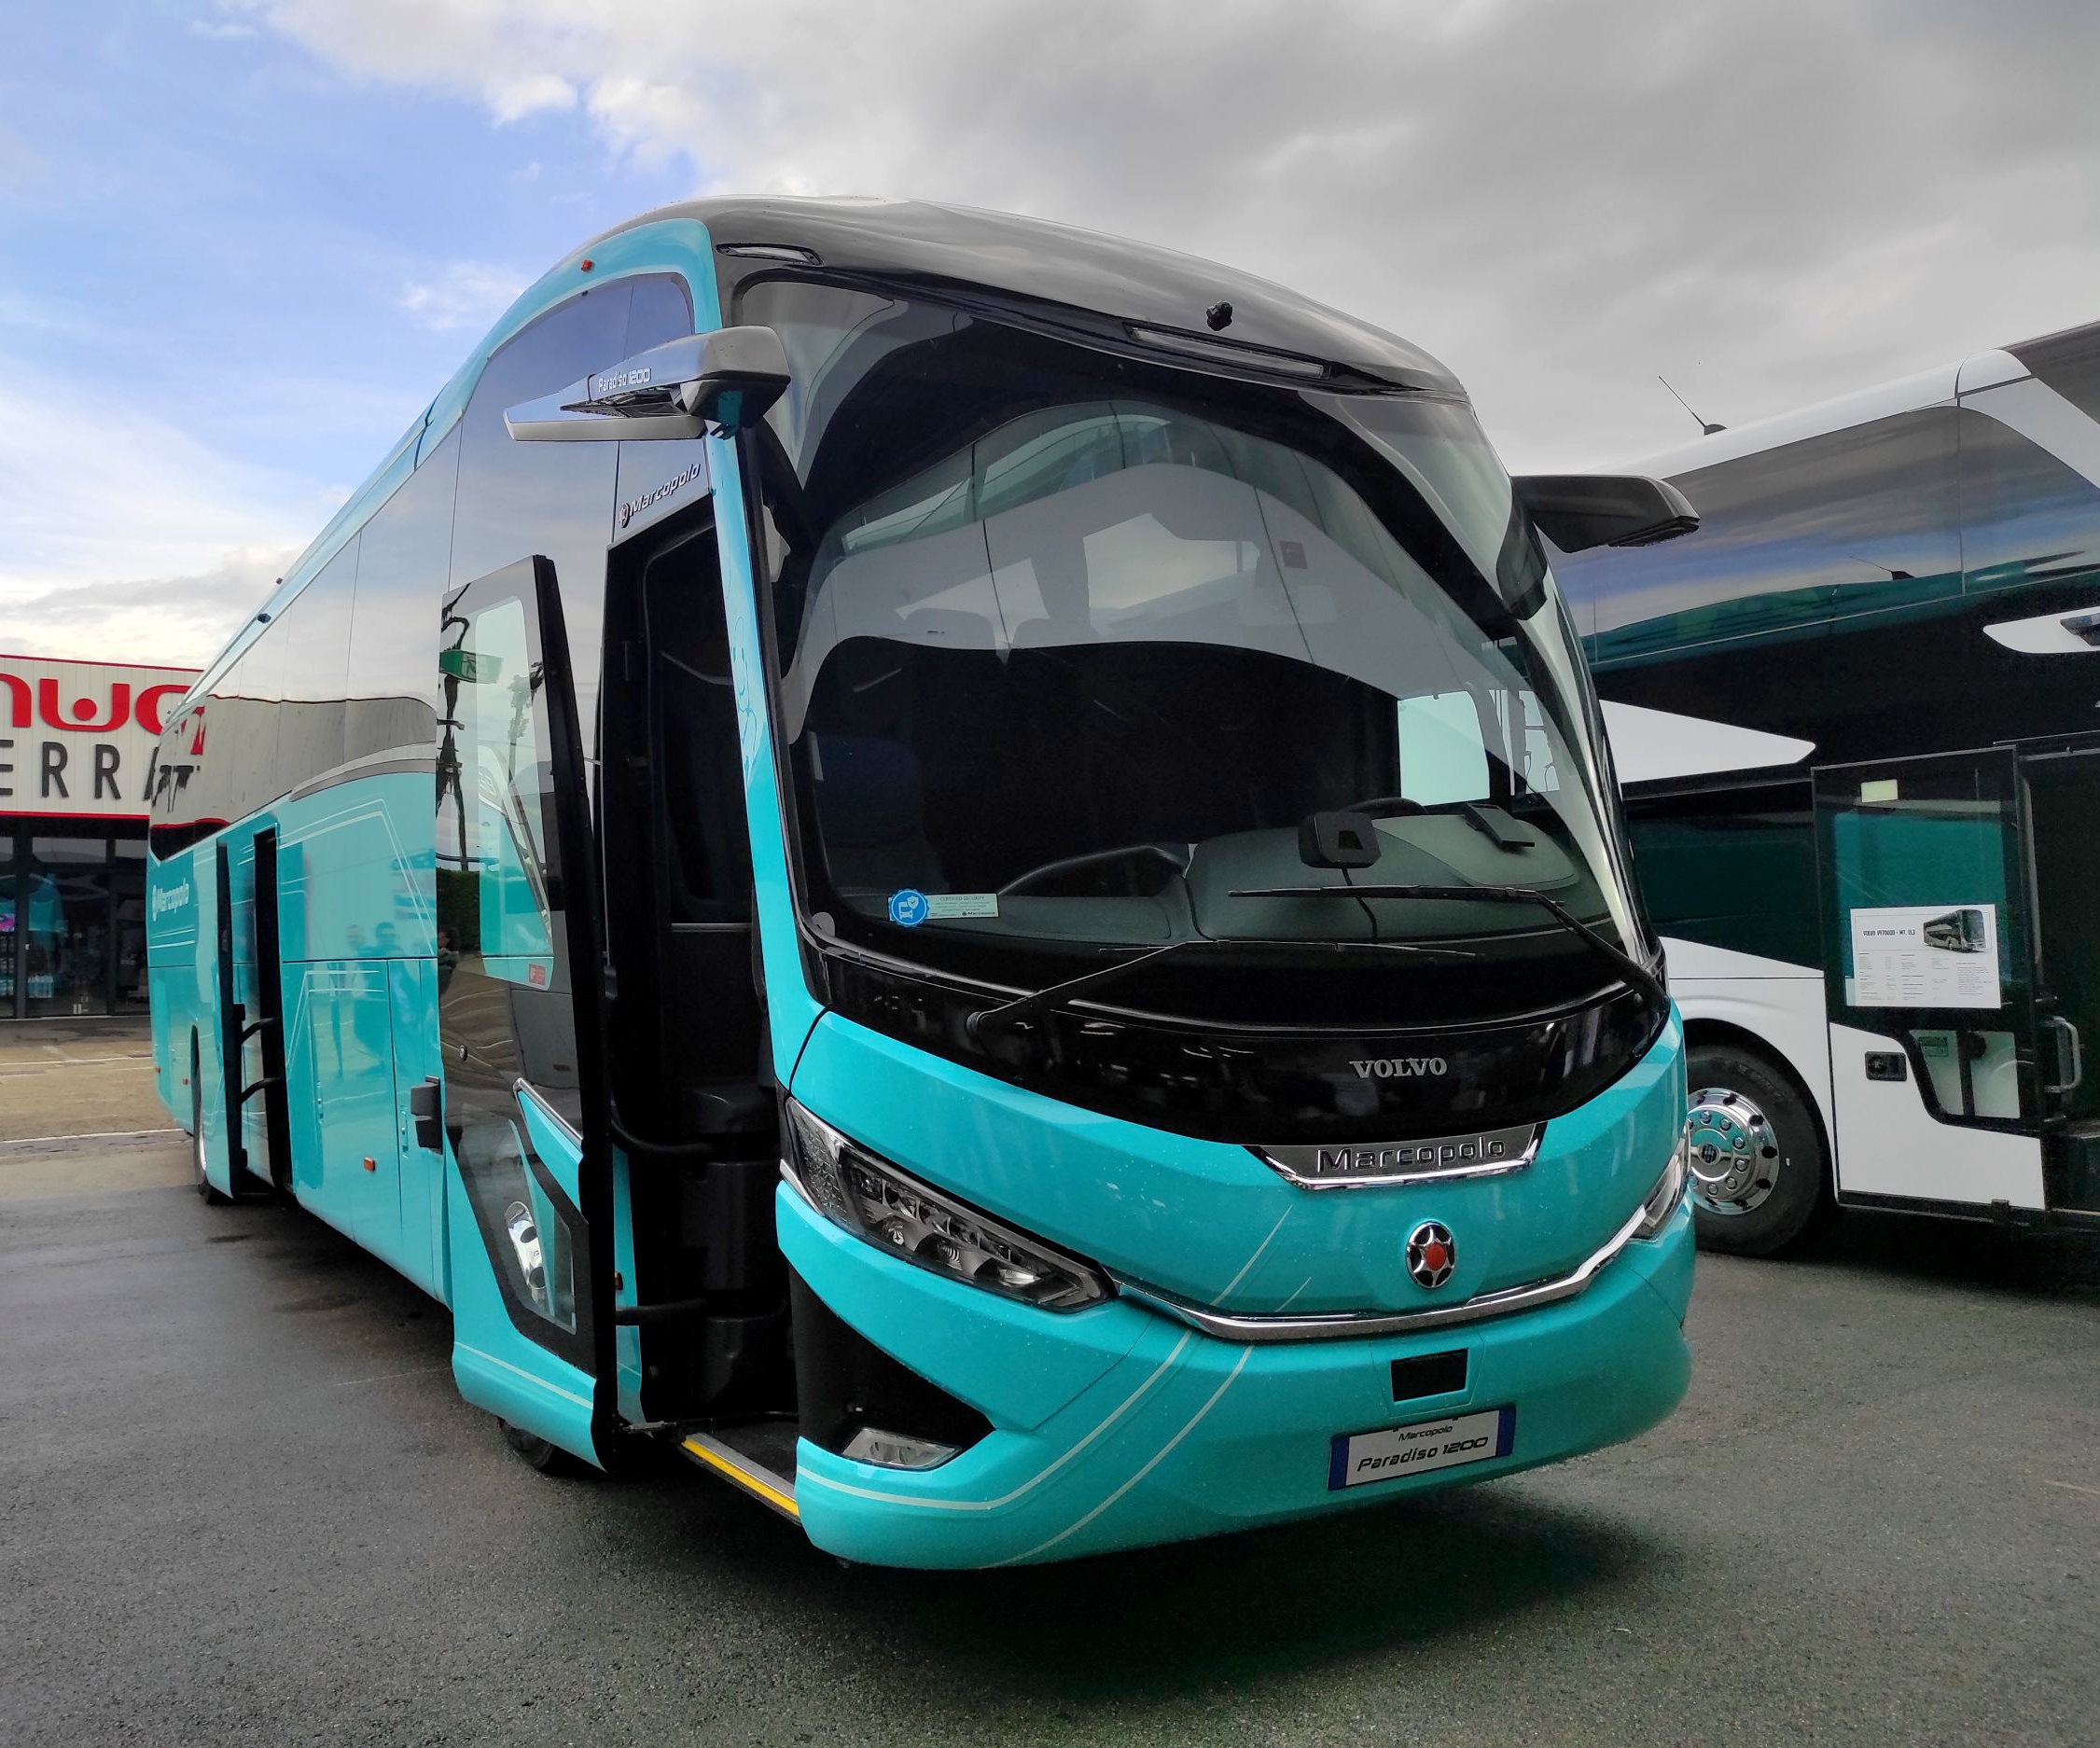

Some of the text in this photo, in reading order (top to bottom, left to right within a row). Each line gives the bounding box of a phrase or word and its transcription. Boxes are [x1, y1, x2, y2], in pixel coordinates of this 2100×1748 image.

[598, 370, 629, 394] Paradiso
[629, 463, 702, 518] Marcopolo
[1348, 1057, 1448, 1078] VOLVO
[1316, 1136, 1506, 1172] Marcopolo
[1398, 1425, 1453, 1441] Marcopolo
[1356, 1436, 1489, 1472] Paradiso 1200
